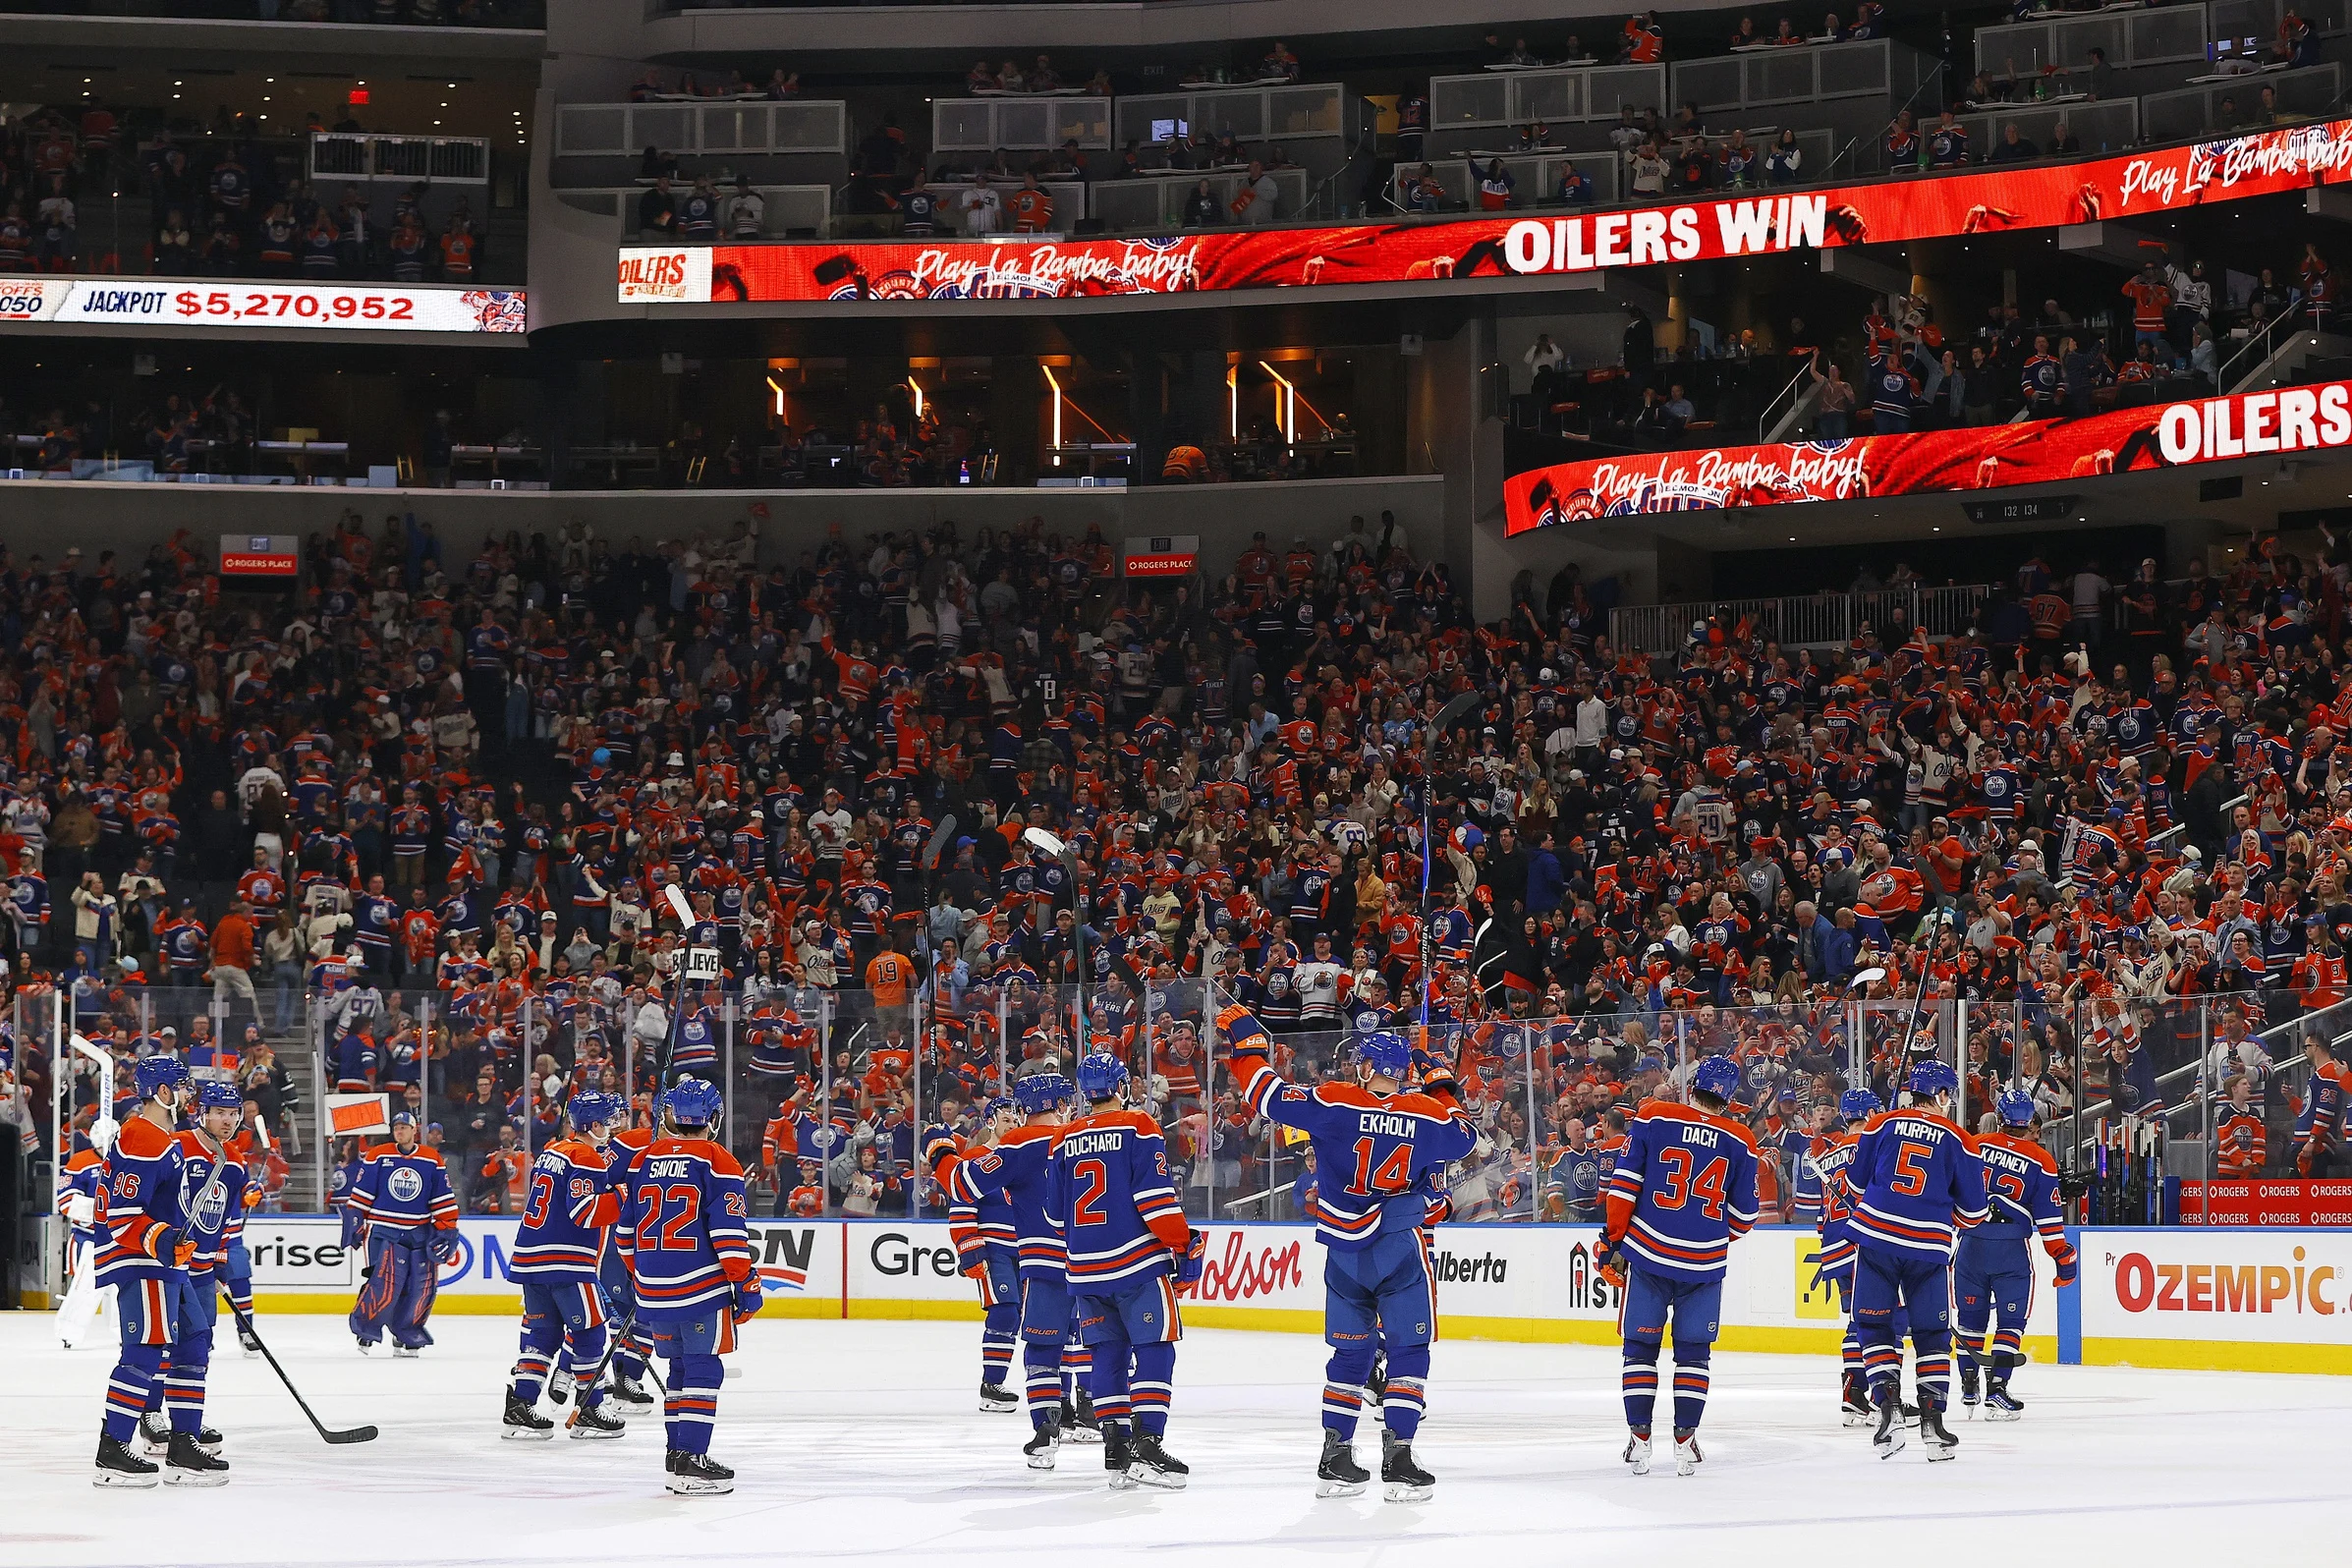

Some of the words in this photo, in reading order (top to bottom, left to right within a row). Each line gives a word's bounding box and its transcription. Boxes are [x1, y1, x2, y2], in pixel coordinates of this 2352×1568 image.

[2119, 159, 2179, 207] Play
[2182, 144, 2216, 195] La
[1504, 207, 1702, 274] OILERS
[1715, 196, 1827, 256] WIN
[617, 253, 686, 284] OILERS
[912, 249, 977, 294] Play
[983, 247, 1022, 287] La
[1122, 244, 1201, 293] baby!
[84, 291, 167, 313] JACKPOT
[175, 290, 415, 322] $5,270,952
[2160, 384, 2352, 466] OILERS
[1589, 463, 1649, 509] Play
[1655, 456, 1689, 499] La
[1789, 446, 1868, 500] baby!
[2004, 506, 2018, 517] 132
[2024, 504, 2038, 516] 134
[235, 559, 267, 569] ROGERS
[1138, 561, 1169, 570] ROGERS
[2036, 602, 2057, 622] 97
[1697, 812, 1719, 838] 29
[876, 961, 899, 983] 19
[2320, 1088, 2337, 1103] 25
[1360, 1113, 1417, 1140] EKHOLM
[1682, 1126, 1719, 1149] DACH
[1894, 1120, 1945, 1146] MURPHY
[1064, 1133, 1123, 1160] OUCHARD
[649, 1159, 690, 1179] SAVOIE
[1154, 1150, 1168, 1177] 2
[1345, 1135, 1416, 1197] 14
[1890, 1141, 1934, 1197] 5
[1981, 1147, 2030, 1175] KAPANEN
[112, 1172, 141, 1199] 96
[570, 1178, 594, 1198] 93
[1073, 1158, 1108, 1228] 2
[1652, 1147, 1730, 1221] 34
[2218, 1186, 2249, 1198] ROGERS
[2268, 1186, 2300, 1198] ROGERS
[2320, 1186, 2352, 1198] ROGERS
[637, 1183, 702, 1252] 22
[724, 1193, 748, 1218] 22
[2218, 1212, 2249, 1224] ROGERS
[2268, 1212, 2300, 1224] ROGERS
[2320, 1212, 2352, 1224] ROGERS
[1433, 1251, 1507, 1283] lberta
[2105, 1252, 2116, 1266] Pr
[1081, 1316, 1106, 1328] CCM
[1859, 1308, 1891, 1316] BAUER
[1025, 1325, 1059, 1336] BAUER
[1331, 1330, 1370, 1342] BAUER
